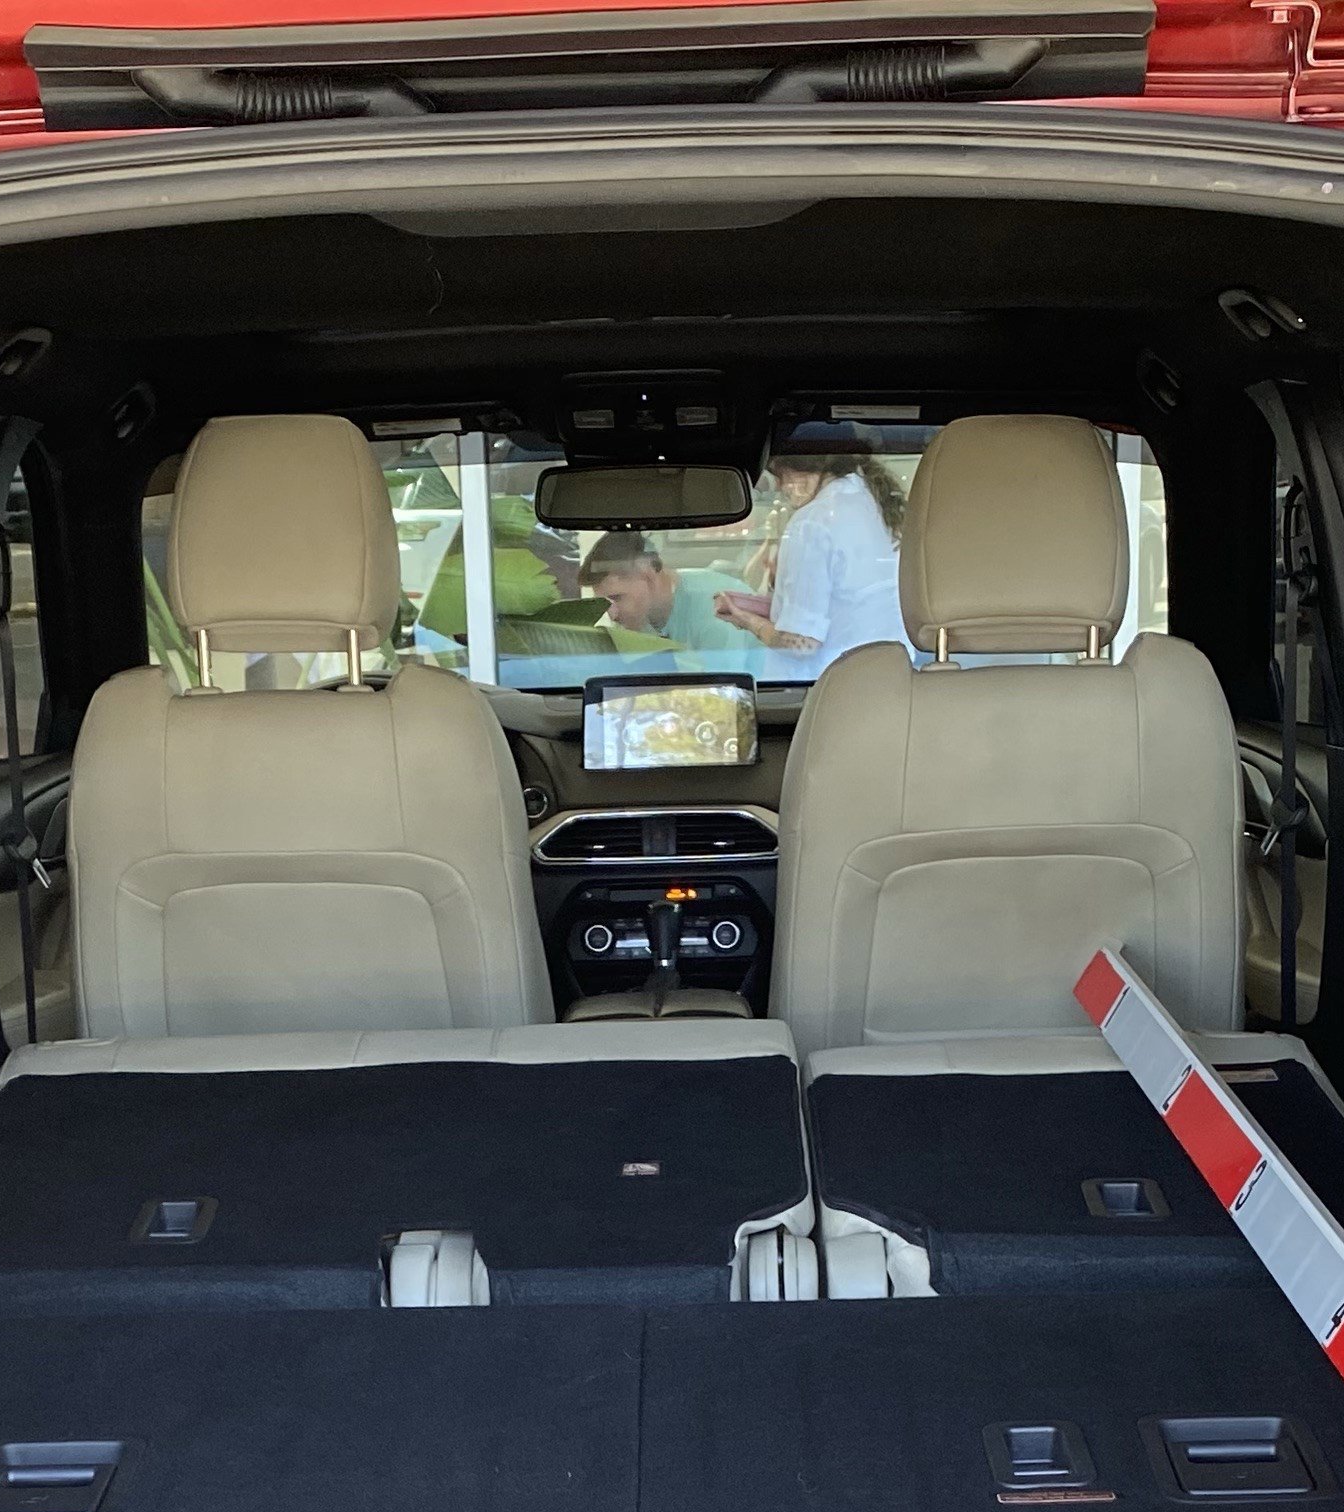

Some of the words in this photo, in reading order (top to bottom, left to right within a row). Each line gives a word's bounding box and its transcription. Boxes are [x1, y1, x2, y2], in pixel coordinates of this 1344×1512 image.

[1104, 986, 1131, 1029] 1
[1162, 1064, 1192, 1112] 2
[1235, 1160, 1268, 1211] 3
